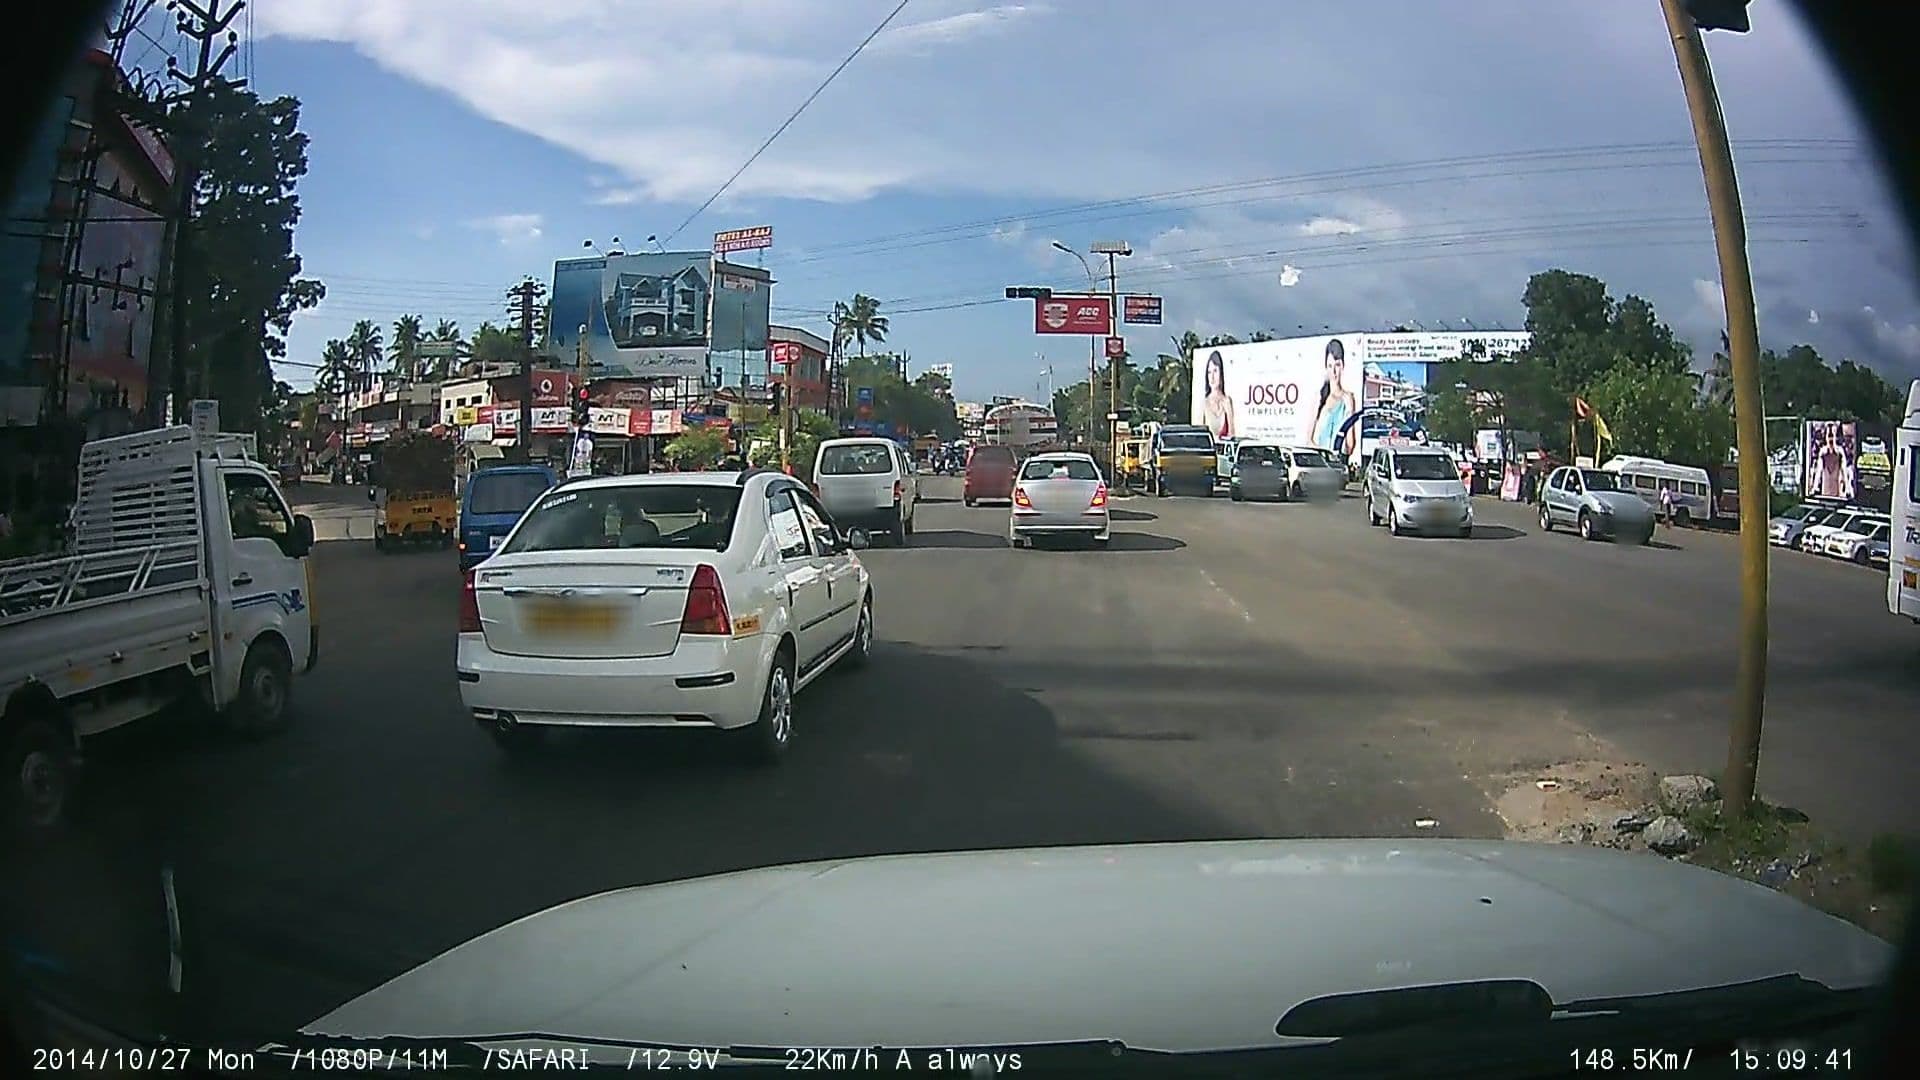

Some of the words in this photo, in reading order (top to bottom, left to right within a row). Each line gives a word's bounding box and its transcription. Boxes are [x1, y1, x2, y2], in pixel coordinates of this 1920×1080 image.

[1076, 307, 1100, 316] ACC
[1244, 383, 1299, 406] JOSCO
[1248, 406, 1295, 416] JEWELLERS
